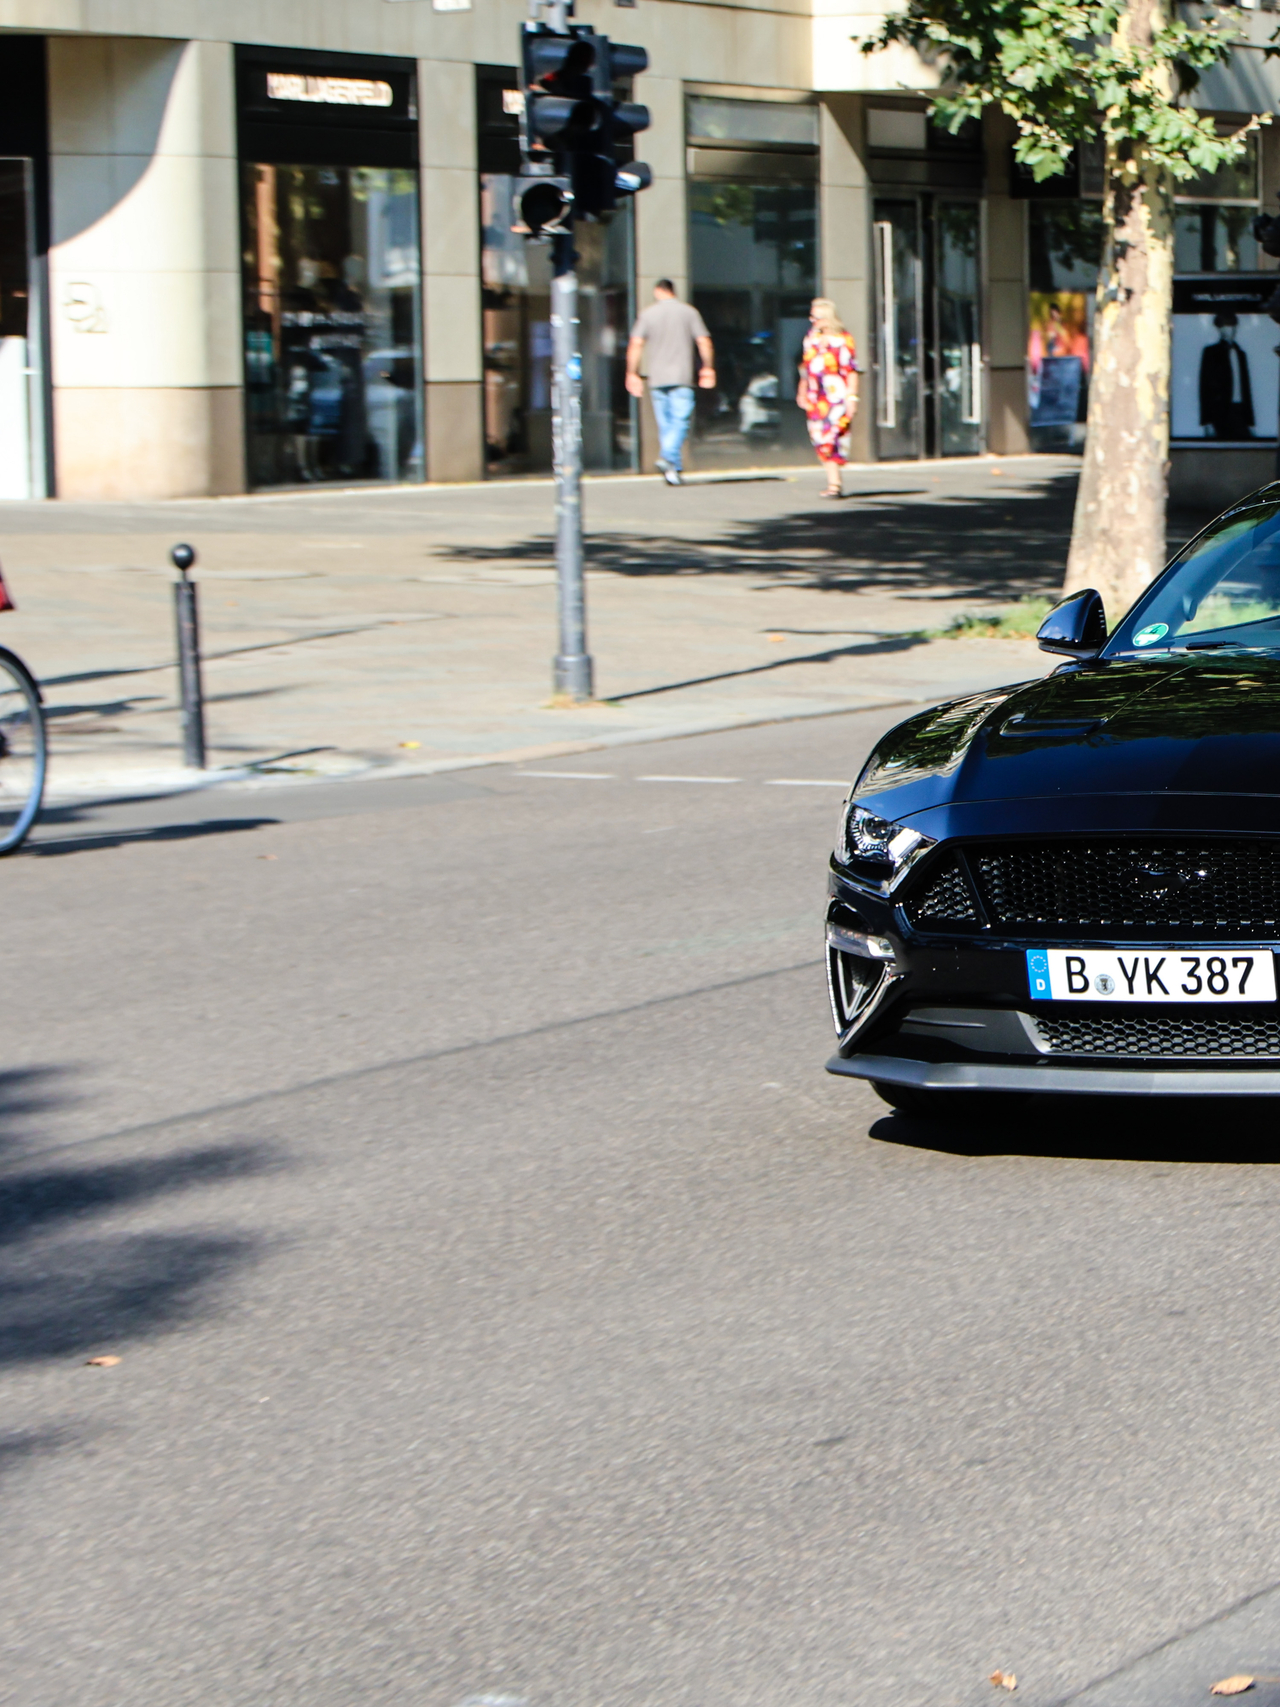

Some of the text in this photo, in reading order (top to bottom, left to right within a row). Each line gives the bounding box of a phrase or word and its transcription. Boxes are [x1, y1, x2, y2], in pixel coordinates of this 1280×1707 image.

[1035, 978, 1046, 991] D
[1065, 956, 1254, 995] B YK 387
